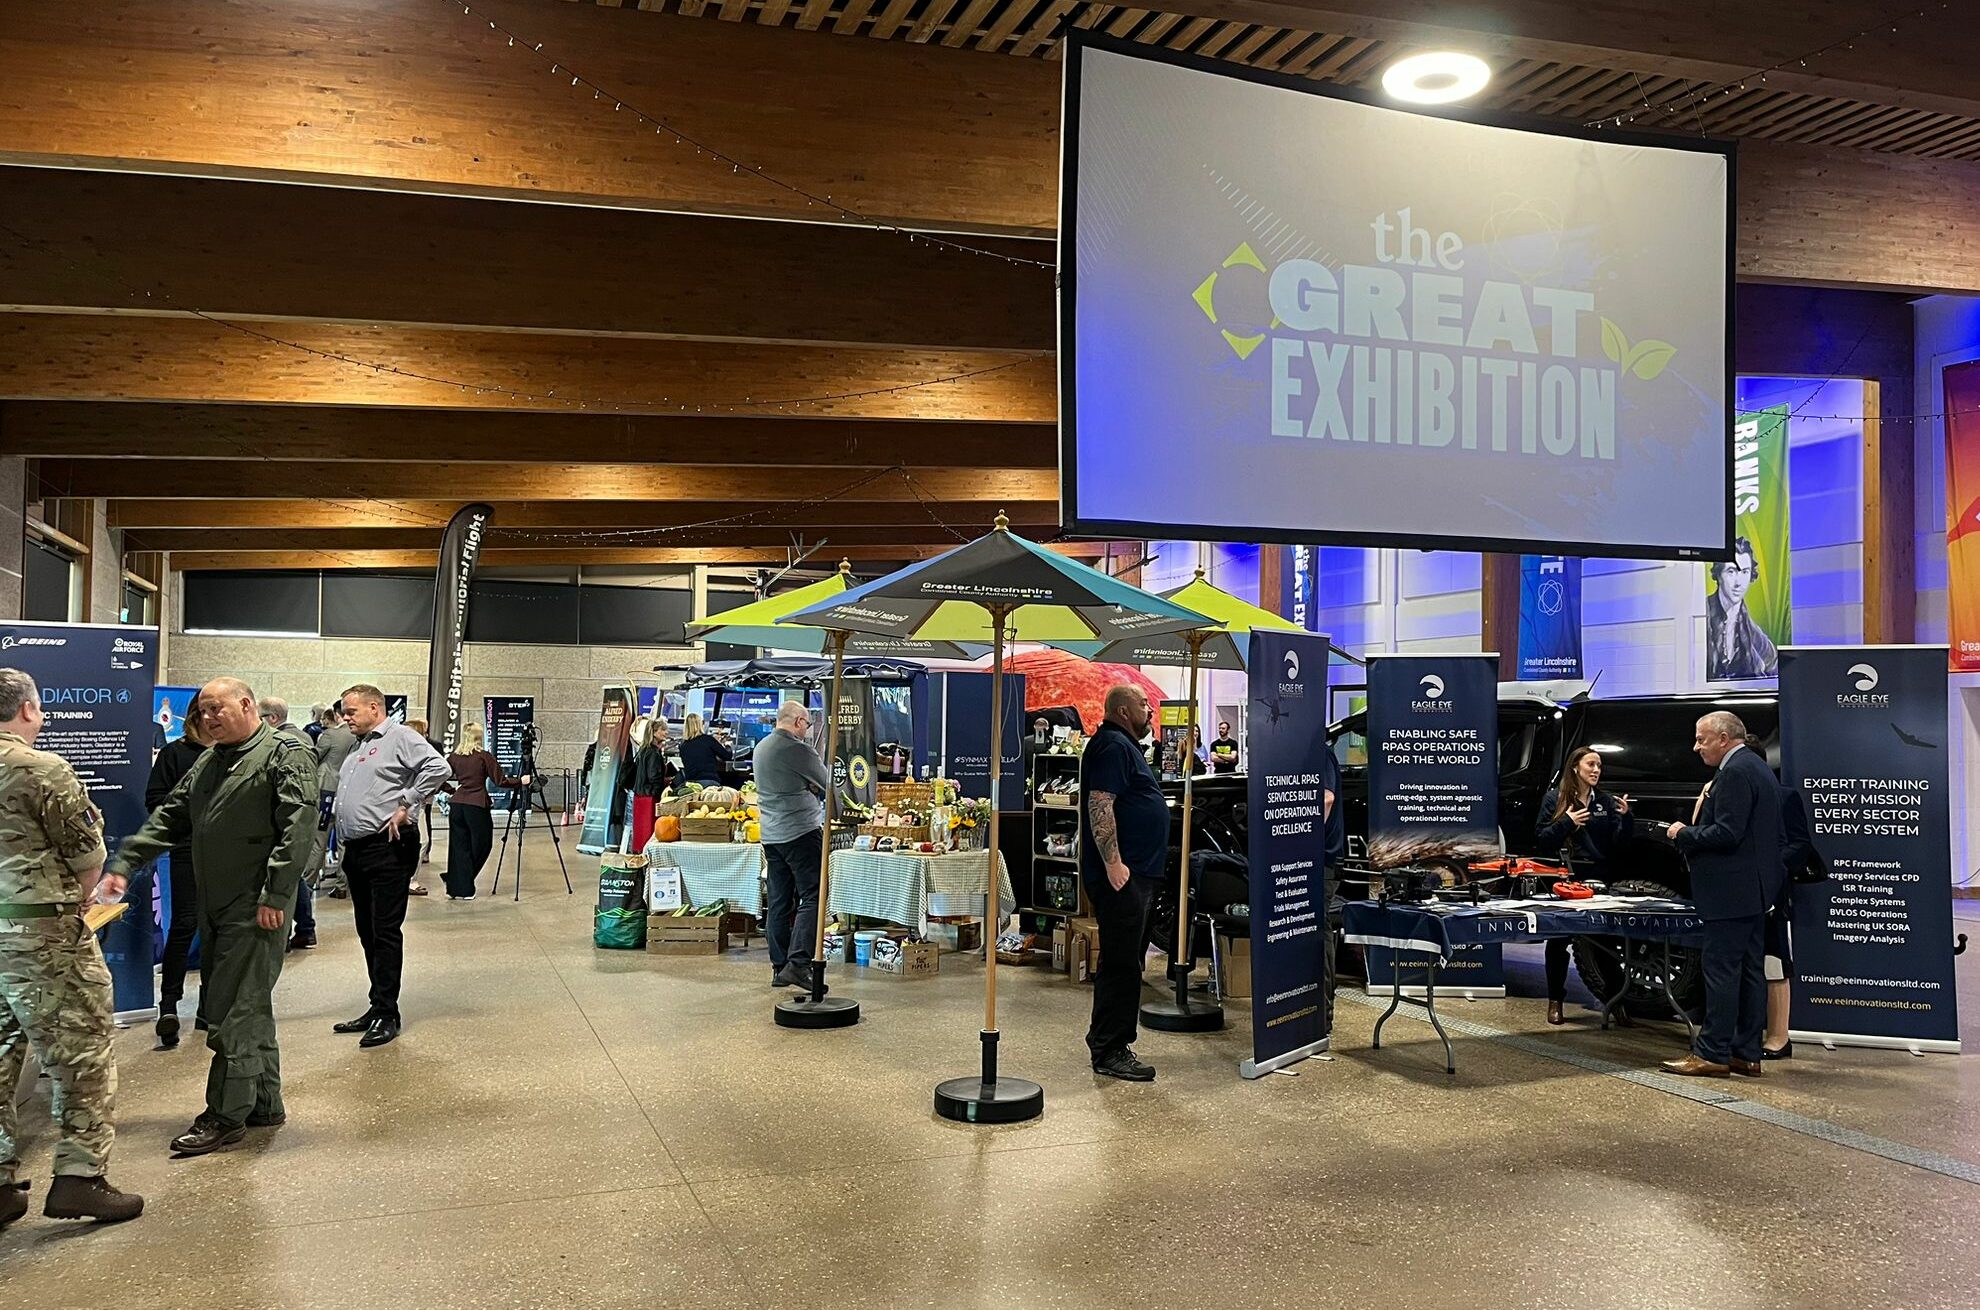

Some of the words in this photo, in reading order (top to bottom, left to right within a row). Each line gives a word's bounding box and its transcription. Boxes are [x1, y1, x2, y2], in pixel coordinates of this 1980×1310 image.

[1370, 207, 1463, 270] the
[1268, 259, 1594, 358] GREAT
[1270, 338, 1615, 460] EXHIBITION
[1735, 420, 1760, 516] BANKS
[1294, 545, 1304, 602] REAT
[922, 582, 971, 591] Greater
[974, 586, 1053, 595] Lincolnshire
[446, 700, 458, 720] of
[462, 514, 484, 560] Flight
[1544, 656, 1576, 666] Lincolnshire
[41, 688, 112, 704] DIATOR
[1837, 694, 1868, 704] EAGLE
[1871, 694, 1889, 704] EYE
[838, 704, 860, 714] FRED
[828, 715, 862, 725] EDERBY
[1390, 729, 1446, 739] ENABLING
[1448, 729, 1477, 739] SAFE
[1382, 742, 1411, 751] RPAS
[1413, 742, 1485, 752] OPERATIONS
[1387, 755, 1410, 764] FOR
[1412, 755, 1434, 764] THE
[1437, 755, 1480, 764] WORLD
[1265, 775, 1300, 787] TECHNICAL
[1302, 774, 1320, 784] RPAS
[1804, 778, 1857, 789] EXPERT
[1860, 779, 1929, 791] TRAINING
[1268, 791, 1298, 803] SERVICES
[1298, 790, 1318, 801] BUILT
[1812, 793, 1857, 804] EVERY
[1861, 794, 1921, 806] MISSION
[1264, 809, 1274, 820] ON
[1275, 806, 1321, 819] OPERATIONAL
[1814, 808, 1859, 819] EVERY
[1863, 809, 1920, 820] SECTOR
[1272, 822, 1312, 836] EXCELLENCE
[1815, 823, 1860, 834] EVERY
[1864, 824, 1919, 836] SYSTEM
[1281, 862, 1297, 872] Support
[1834, 860, 1851, 868] RPC
[1852, 860, 1901, 869] Framework
[1276, 877, 1288, 886] Safety
[1288, 875, 1308, 883] Assurance
[1828, 873, 1863, 882] ergency
[1864, 873, 1900, 882] Services
[1902, 874, 1920, 882] CPD
[1288, 888, 1308, 896] Evaluation
[1858, 885, 1894, 894] Training
[1285, 900, 1310, 910] Management
[1831, 896, 1868, 906] Complex
[1870, 898, 1906, 907] Systems
[1269, 917, 1286, 928] Research
[1290, 912, 1316, 923] Development
[1860, 910, 1907, 919] Operations
[1828, 921, 1870, 931] Mastering
[1886, 923, 1910, 931] SORA
[1267, 931, 1289, 943] Engineering
[1293, 925, 1318, 936] Maintenance
[1833, 933, 1868, 944] Imagery
[1870, 935, 1905, 944] Analysis
[1801, 974, 1940, 990] training@eeinnovationsltd.com
[1810, 996, 1931, 1010] www.eeinnovationsltd.com
